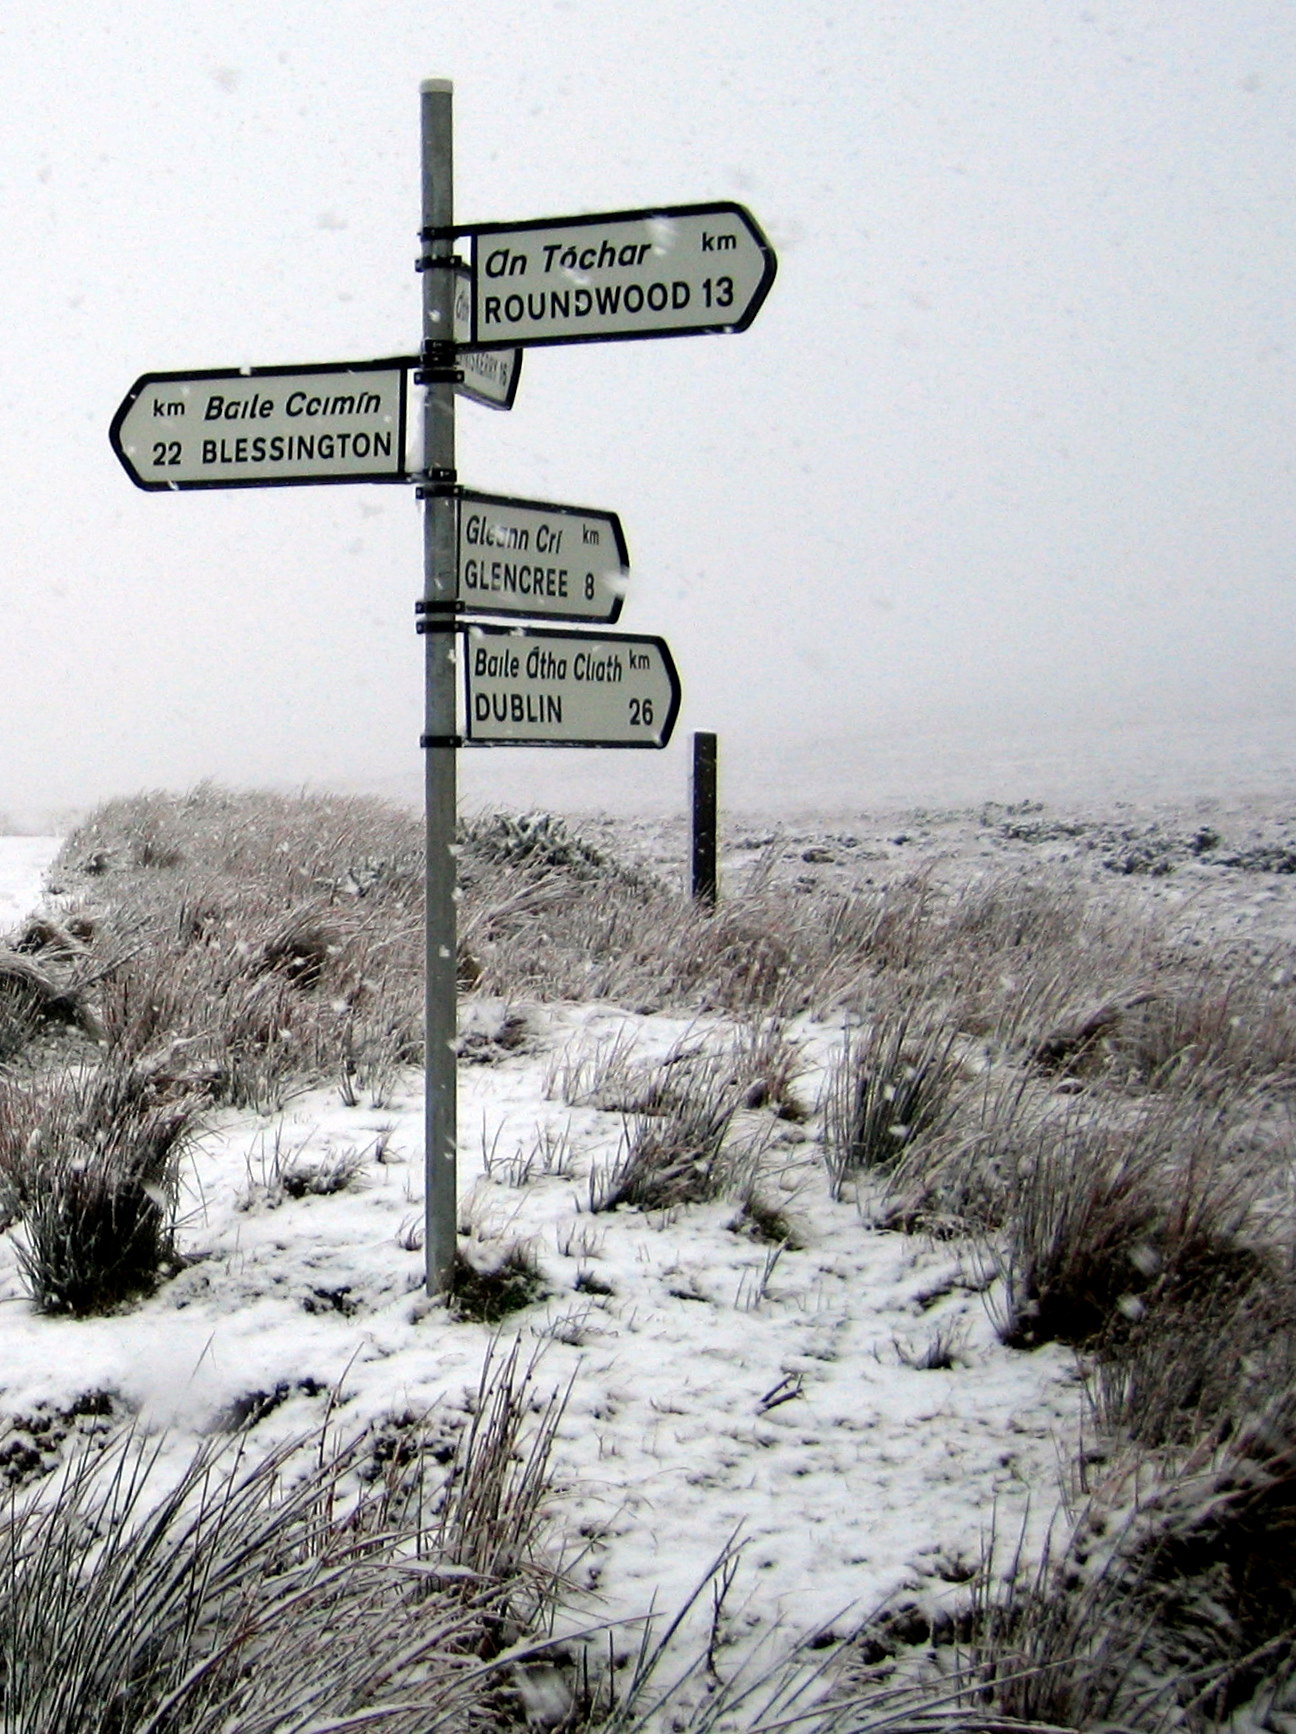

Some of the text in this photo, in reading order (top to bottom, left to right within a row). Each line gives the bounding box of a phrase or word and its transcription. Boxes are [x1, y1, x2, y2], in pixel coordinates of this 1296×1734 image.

[484, 231, 737, 279] An Tóchar km
[484, 281, 691, 324] ROUNDWOOD
[701, 275, 734, 309] 13
[153, 398, 186, 418] km
[204, 393, 275, 421] Baile
[152, 431, 392, 467] 22 BLESSINGTON
[535, 523, 564, 555] Crí
[582, 524, 600, 546] km
[464, 558, 595, 600] GLENCREE 8
[474, 647, 520, 679] Baile
[573, 652, 623, 683] Cliath
[628, 648, 651, 670] km
[474, 692, 654, 727] DUBLIN 26
